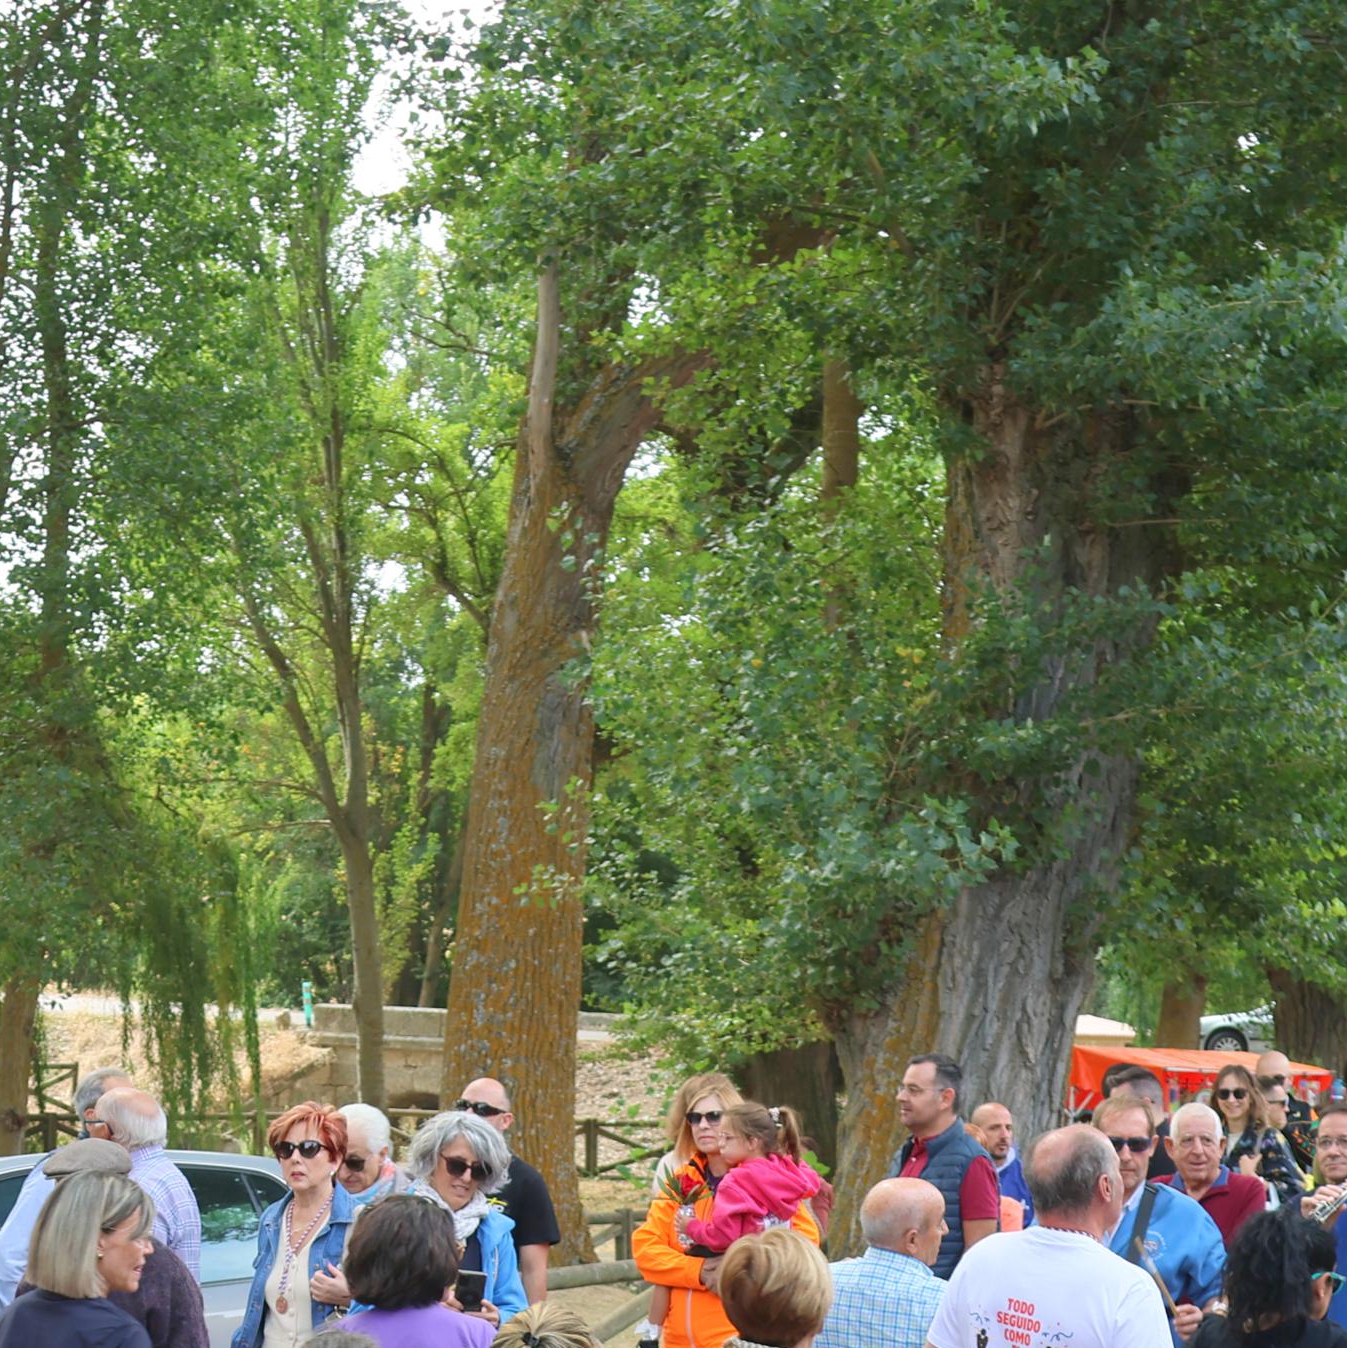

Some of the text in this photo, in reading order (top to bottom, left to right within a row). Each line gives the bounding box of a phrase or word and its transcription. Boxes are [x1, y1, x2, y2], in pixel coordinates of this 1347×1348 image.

[1007, 1298, 1035, 1316] TODO
[996, 1311, 1041, 1333] SEGUIDO
[1004, 1328, 1031, 1346] COMO
